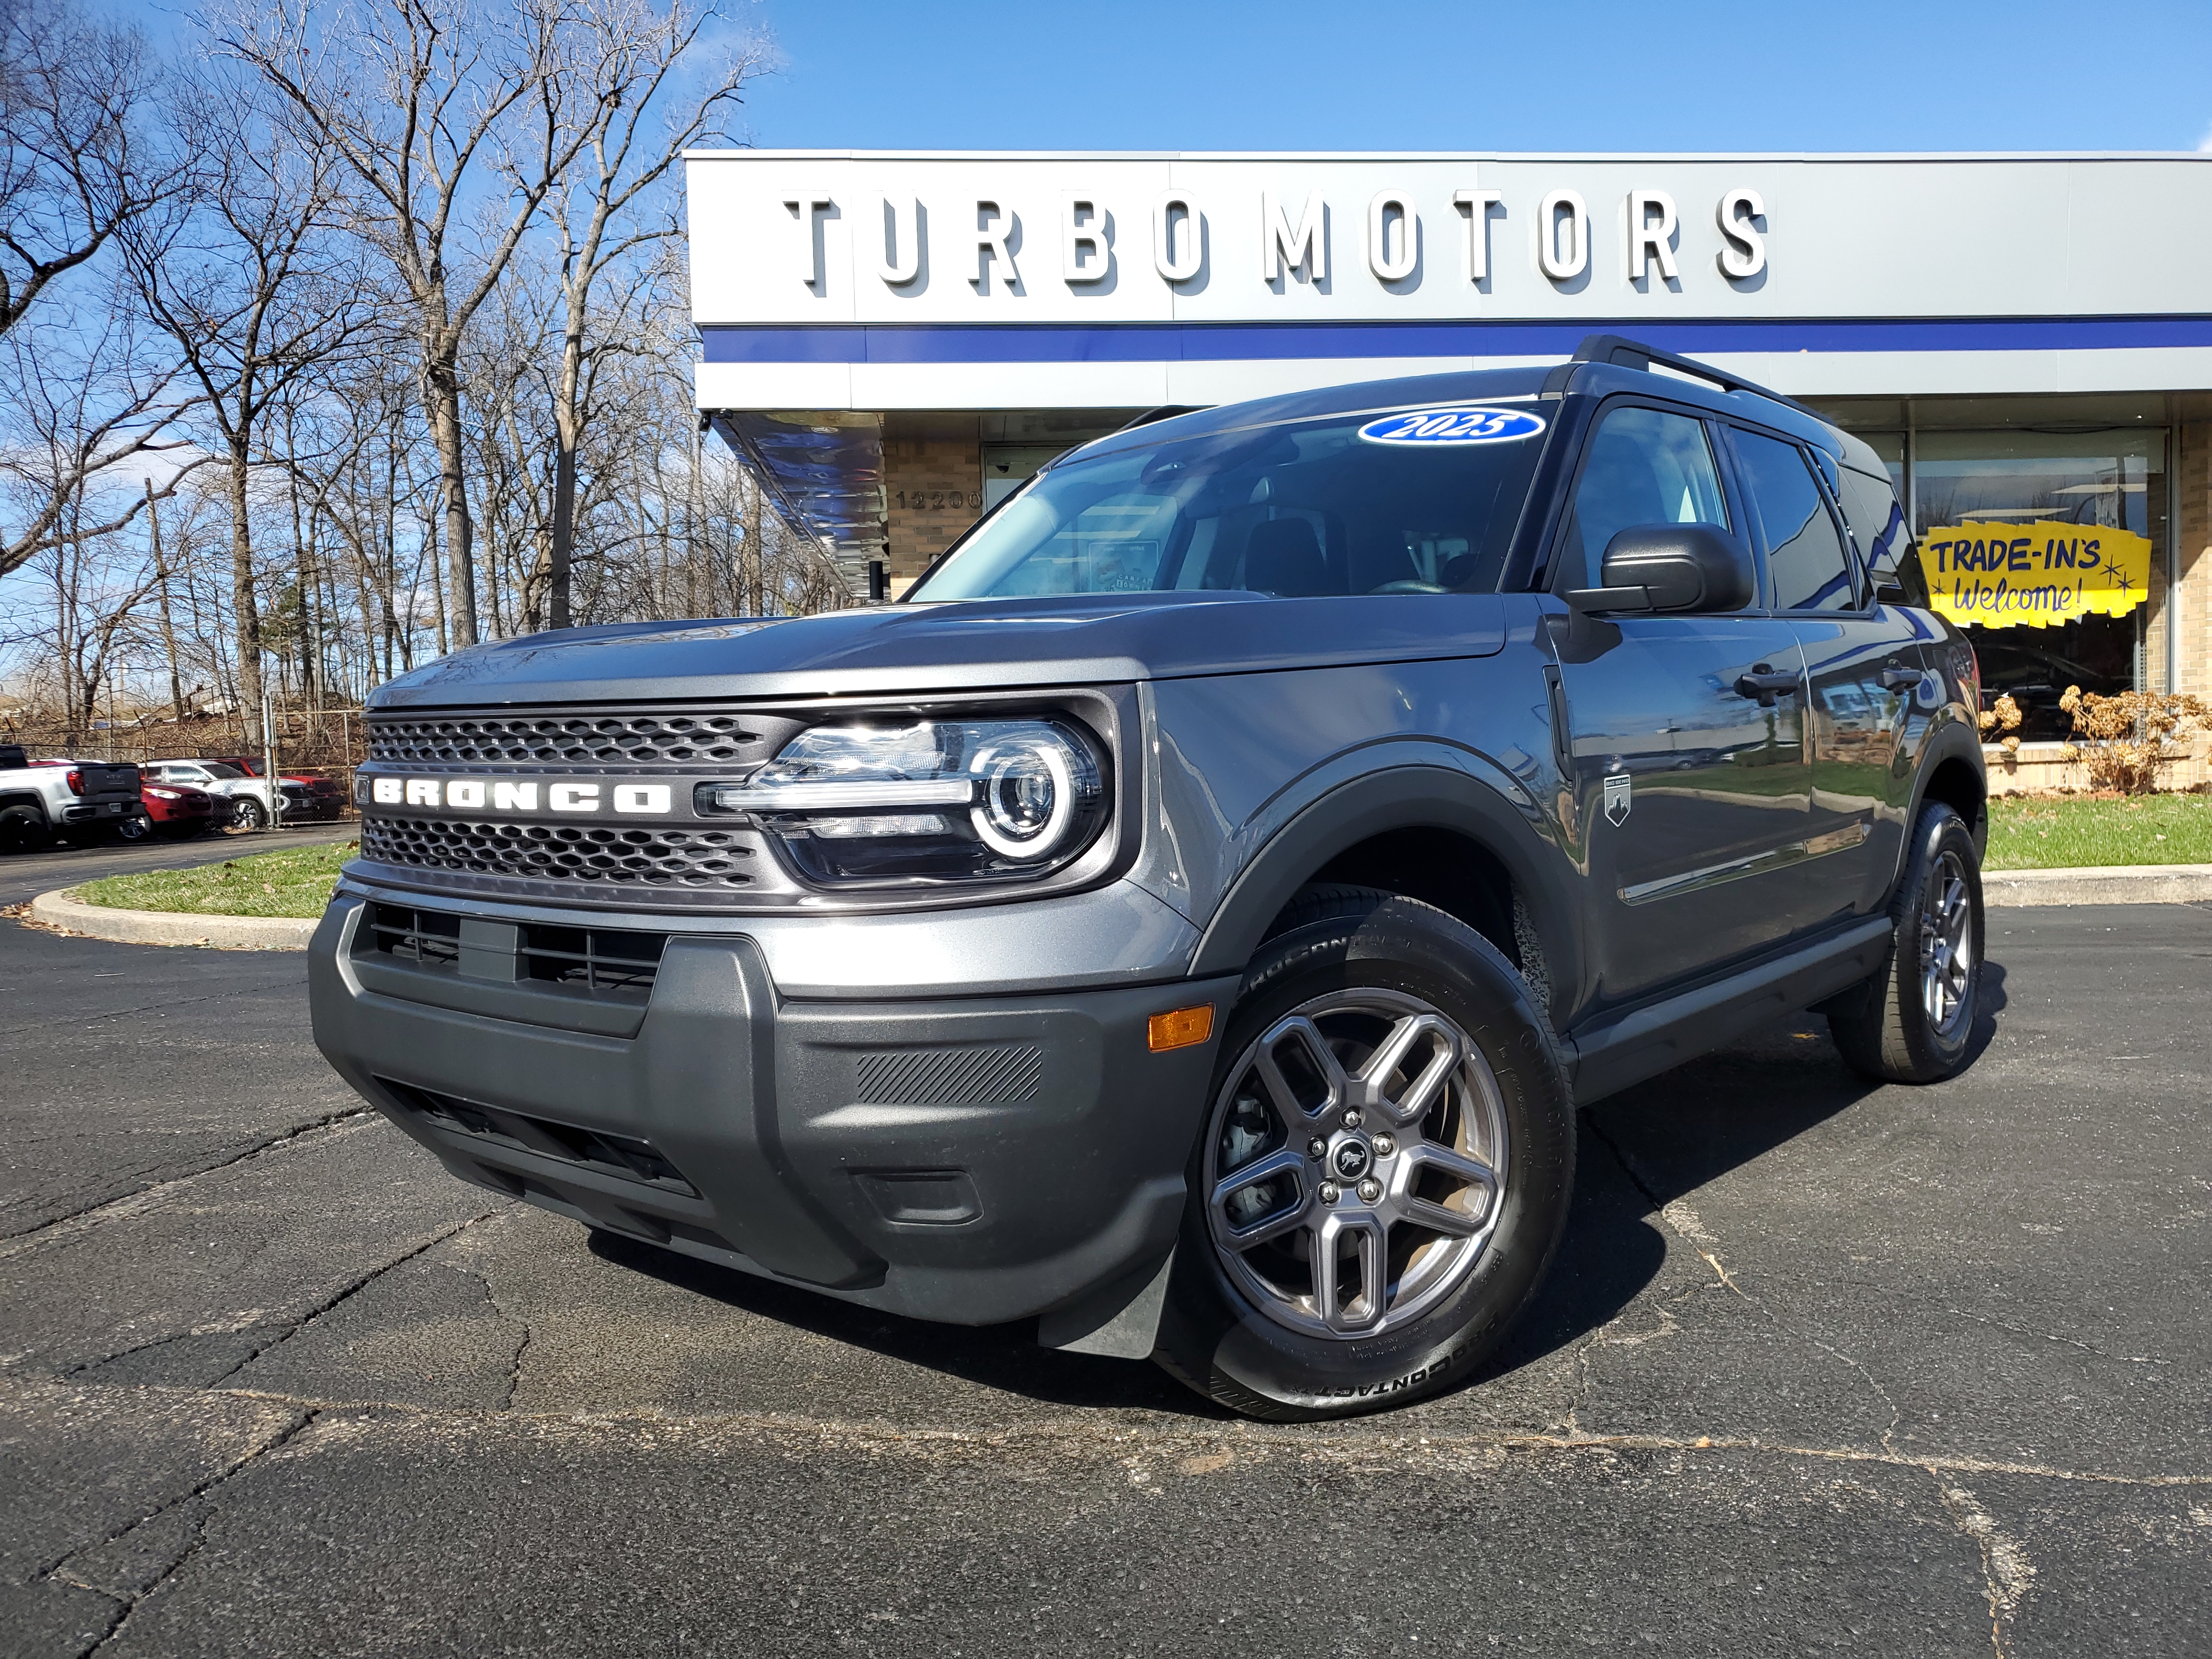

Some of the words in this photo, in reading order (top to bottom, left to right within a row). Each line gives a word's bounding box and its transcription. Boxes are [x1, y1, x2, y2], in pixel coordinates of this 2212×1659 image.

[782, 189, 1201, 284] TURBO
[1262, 188, 1765, 281] MOTORS
[1381, 414, 1520, 438] 2025
[896, 491, 981, 509] 12200
[1929, 538, 2101, 572] TRADE-IN'S
[1954, 577, 2083, 613] Welcome!
[374, 778, 672, 814] BRONCO
